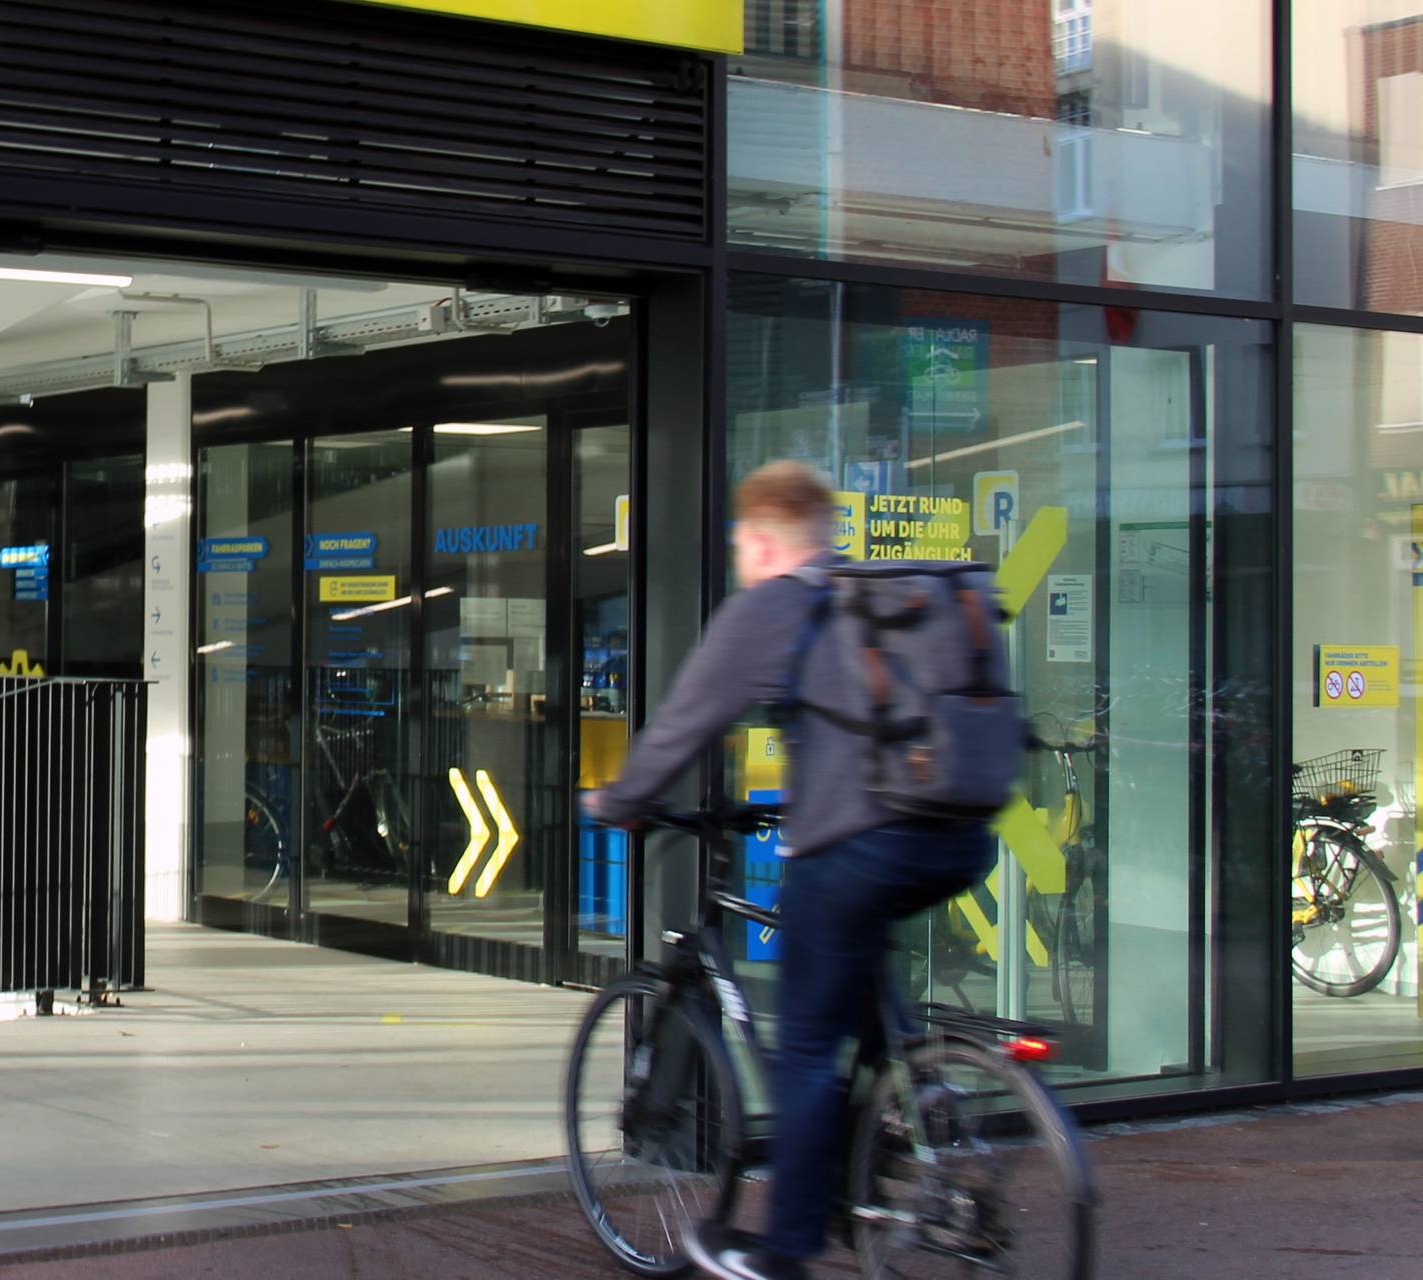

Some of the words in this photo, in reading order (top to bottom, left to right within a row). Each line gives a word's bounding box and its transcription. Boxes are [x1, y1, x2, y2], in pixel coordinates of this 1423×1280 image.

[870, 495, 917, 513] JETZT
[920, 497, 962, 515] RUND
[994, 491, 1014, 530] R
[434, 524, 539, 552] AUSKUNFT
[870, 521, 895, 538] UM
[899, 521, 923, 538] DIE
[928, 522, 960, 540] UHR
[870, 542, 972, 561] ZUGÄNGLICH
